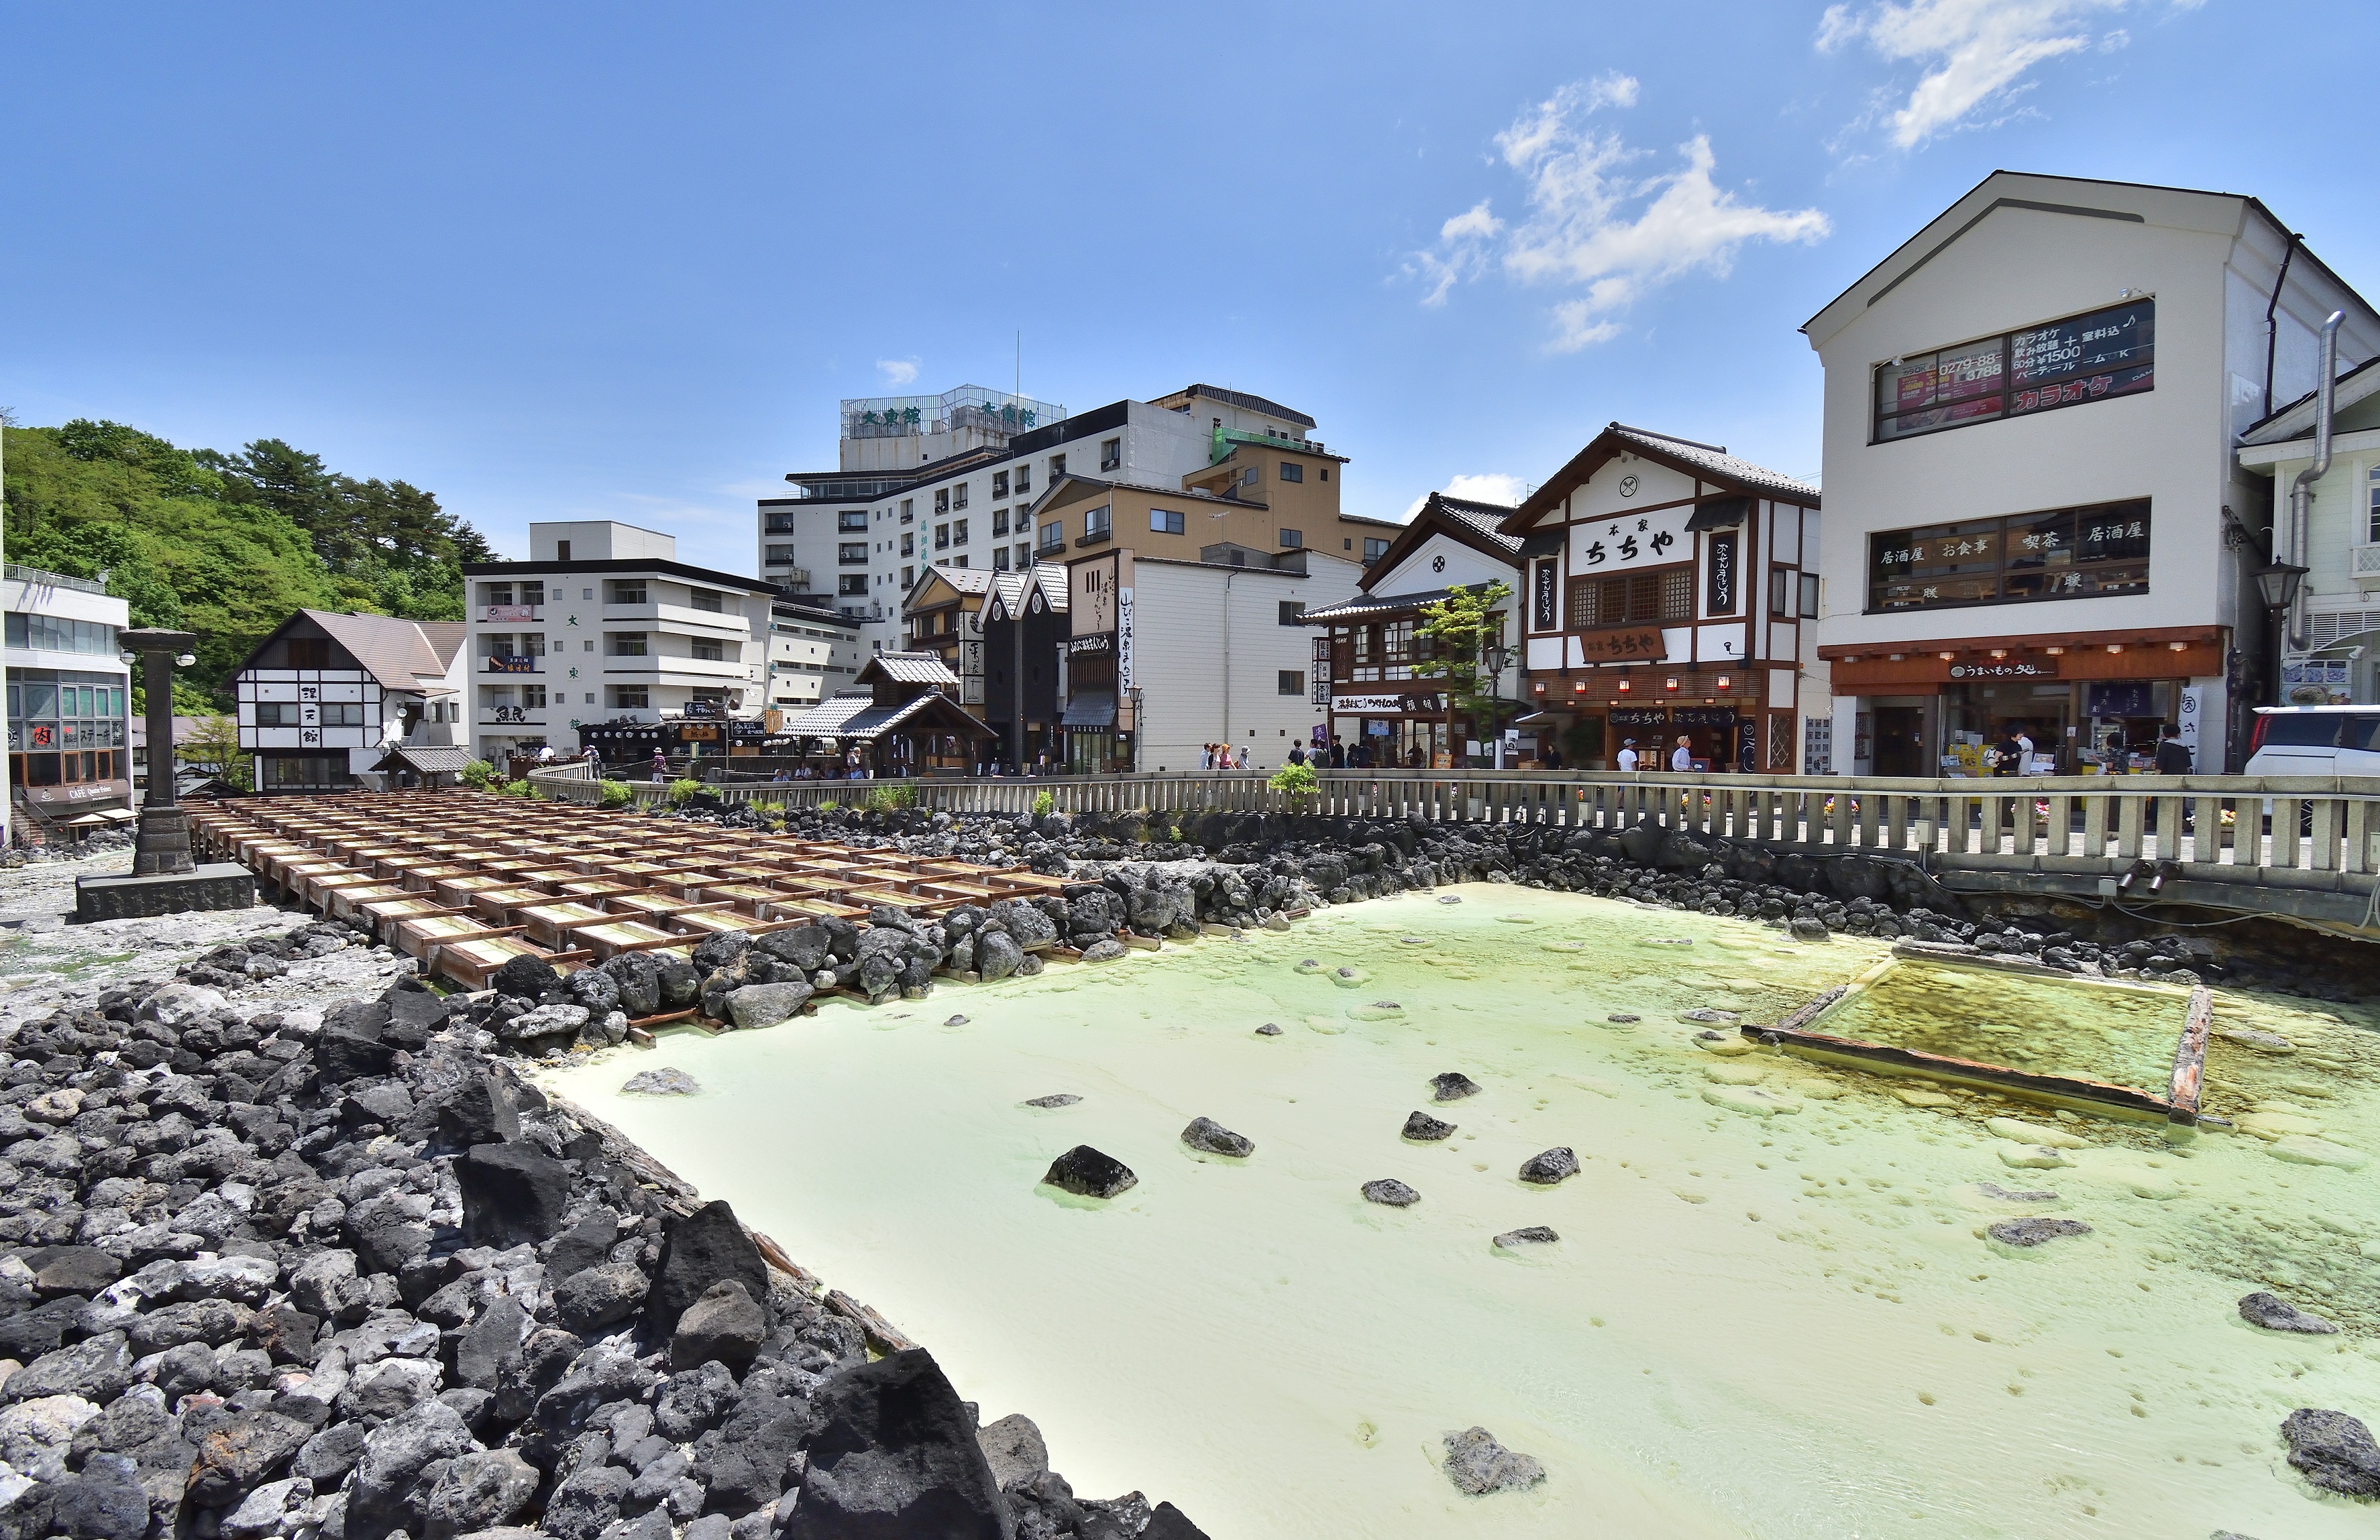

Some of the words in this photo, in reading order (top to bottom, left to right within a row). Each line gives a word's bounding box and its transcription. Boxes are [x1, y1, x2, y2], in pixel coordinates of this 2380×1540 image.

[2015, 329, 2060, 347] カラオケ
[2015, 342, 2059, 359] 飲み放題
[1966, 363, 2002, 381] 3788
[2017, 375, 2112, 411] カラオケ
[2131, 369, 2153, 381] DAM
[1585, 530, 1674, 566] ちちや
[1880, 547, 1925, 565] 居酒屋
[1943, 539, 1988, 557] お食事
[2021, 531, 2060, 550] 喫茶
[2087, 521, 2144, 542] 居酒屋
[496, 705, 526, 722] 魚民
[80, 729, 111, 741] ステーキ
